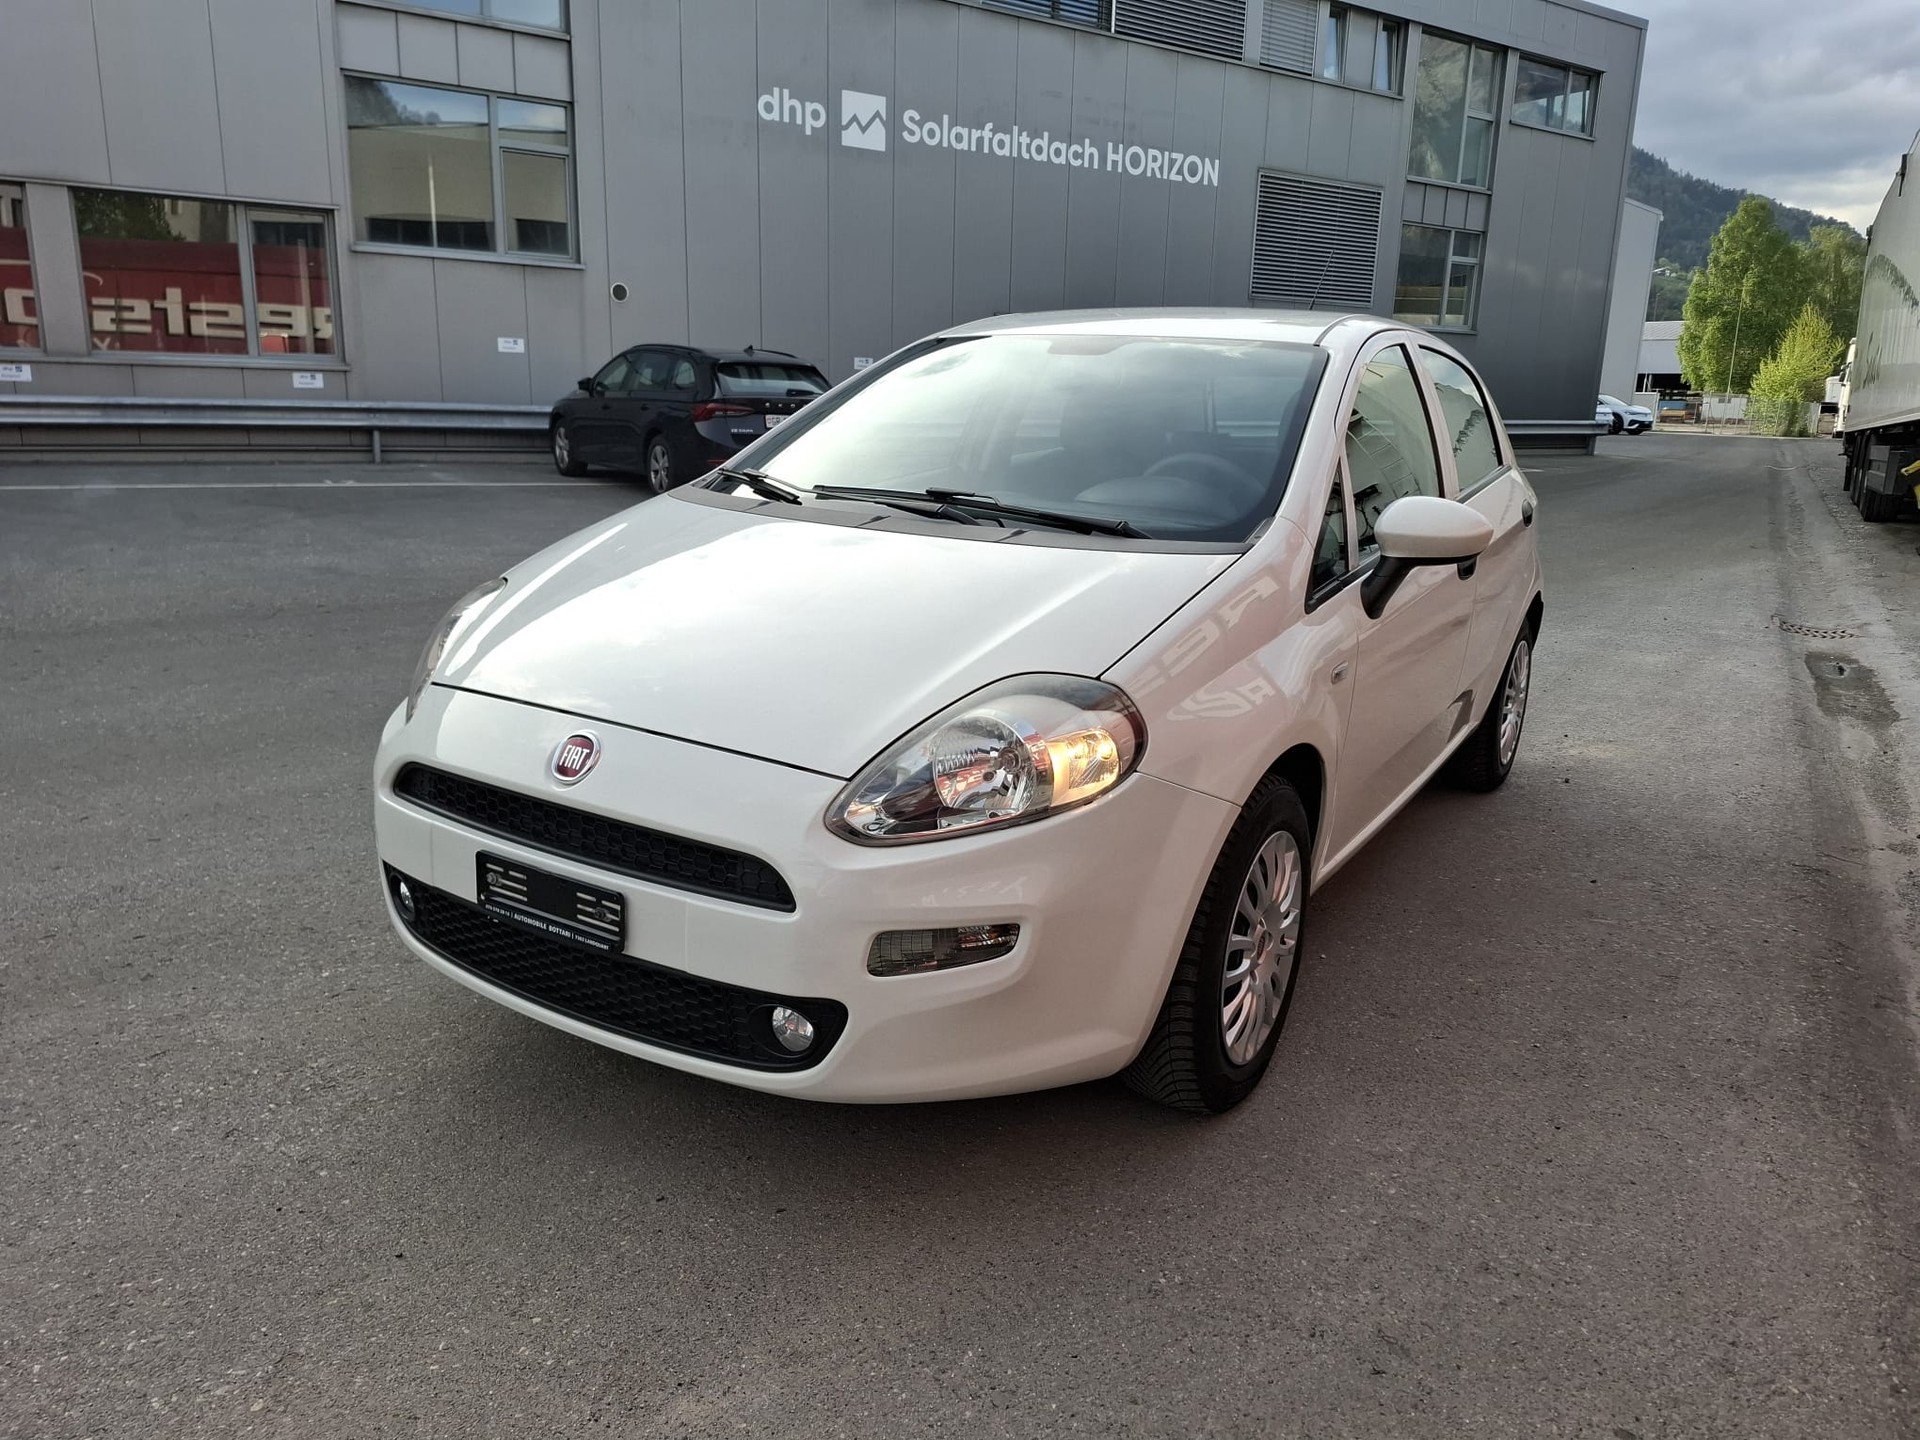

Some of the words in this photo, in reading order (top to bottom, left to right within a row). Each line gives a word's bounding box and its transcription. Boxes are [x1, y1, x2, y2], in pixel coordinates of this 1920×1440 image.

[757, 87, 826, 135] dhp
[902, 109, 1099, 169] Solarfaltdach
[1106, 142, 1220, 187] HORIZON
[559, 744, 590, 770] FIAT
[514, 913, 547, 930] AUTOMOBILE
[548, 925, 571, 938] BOTTARI
